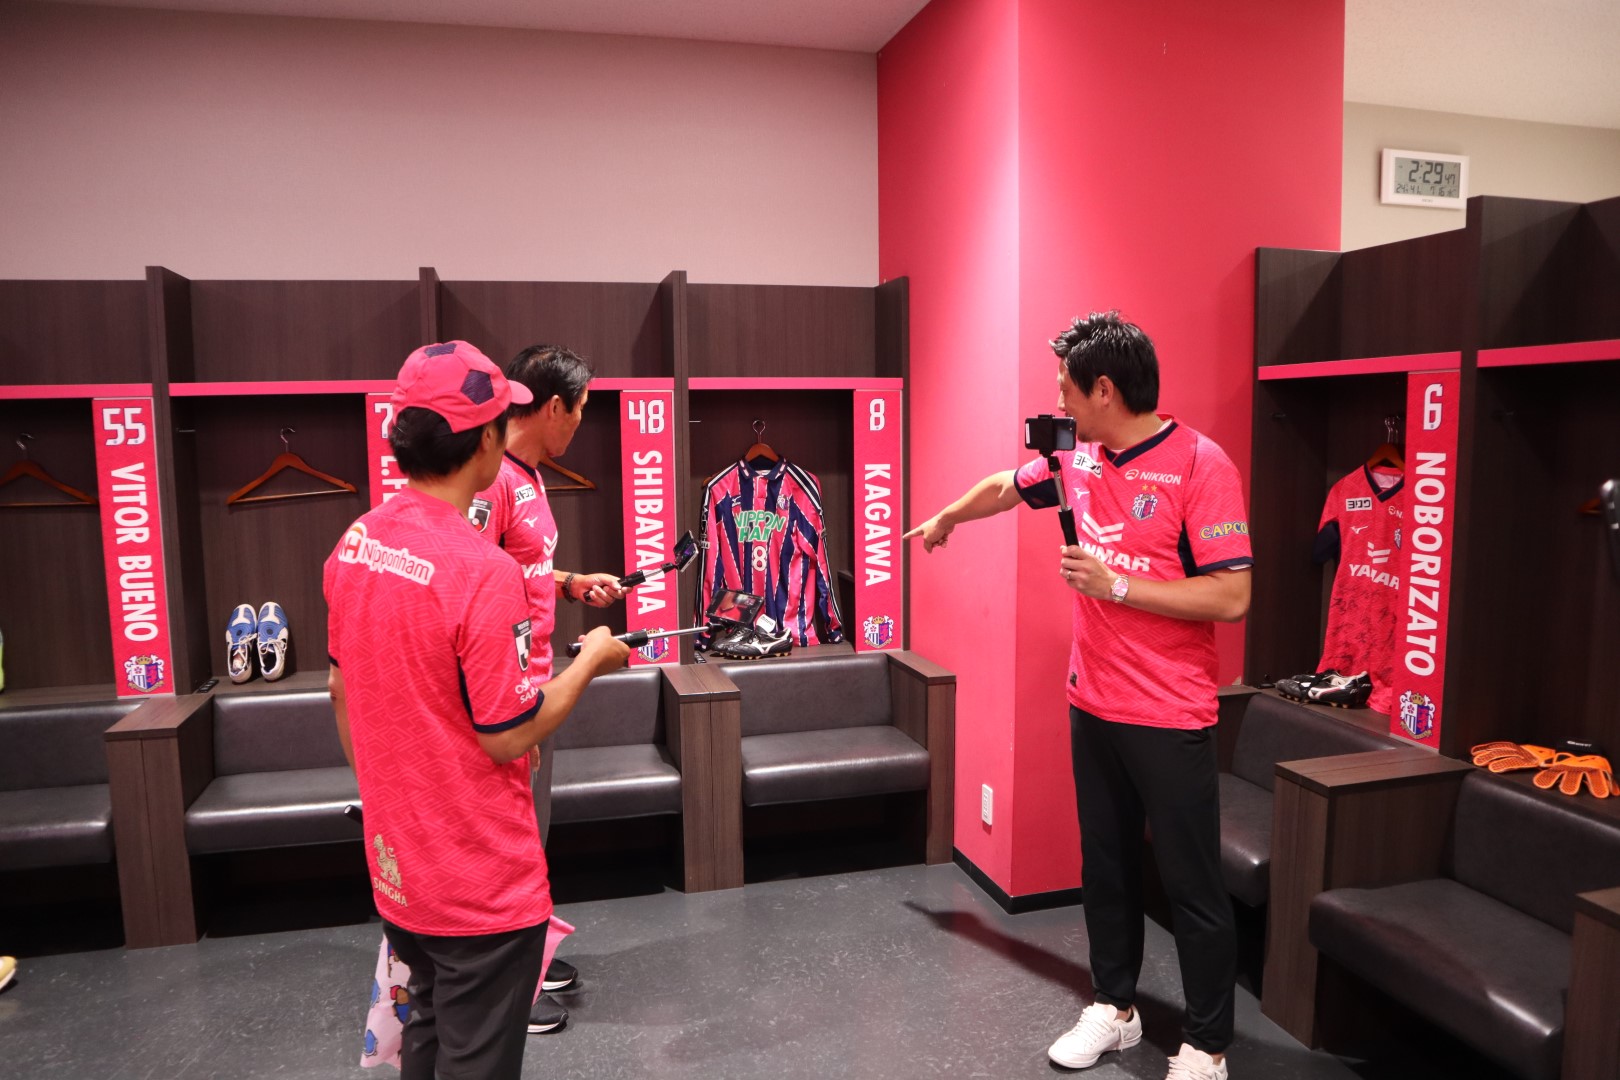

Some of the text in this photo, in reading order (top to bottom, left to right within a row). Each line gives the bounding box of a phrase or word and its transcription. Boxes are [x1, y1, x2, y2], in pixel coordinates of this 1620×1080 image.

[1409, 160, 1444, 184] 2:29
[374, 403, 393, 439] 7
[628, 399, 664, 434] 48
[869, 398, 885, 431] 8
[1423, 383, 1443, 430] 6
[102, 407, 146, 446] 55
[1140, 471, 1182, 486] NIKKON
[632, 450, 667, 615] SHIBAYAMA
[864, 463, 892, 587] KAGAWA
[1200, 521, 1249, 540] CAPCO
[110, 461, 159, 642] VITOR BUENO
[362, 541, 430, 581] Nipponham
[753, 545, 767, 572] 8
[1404, 451, 1447, 677] NOBORIZATO
[374, 877, 408, 907] SINGHA
